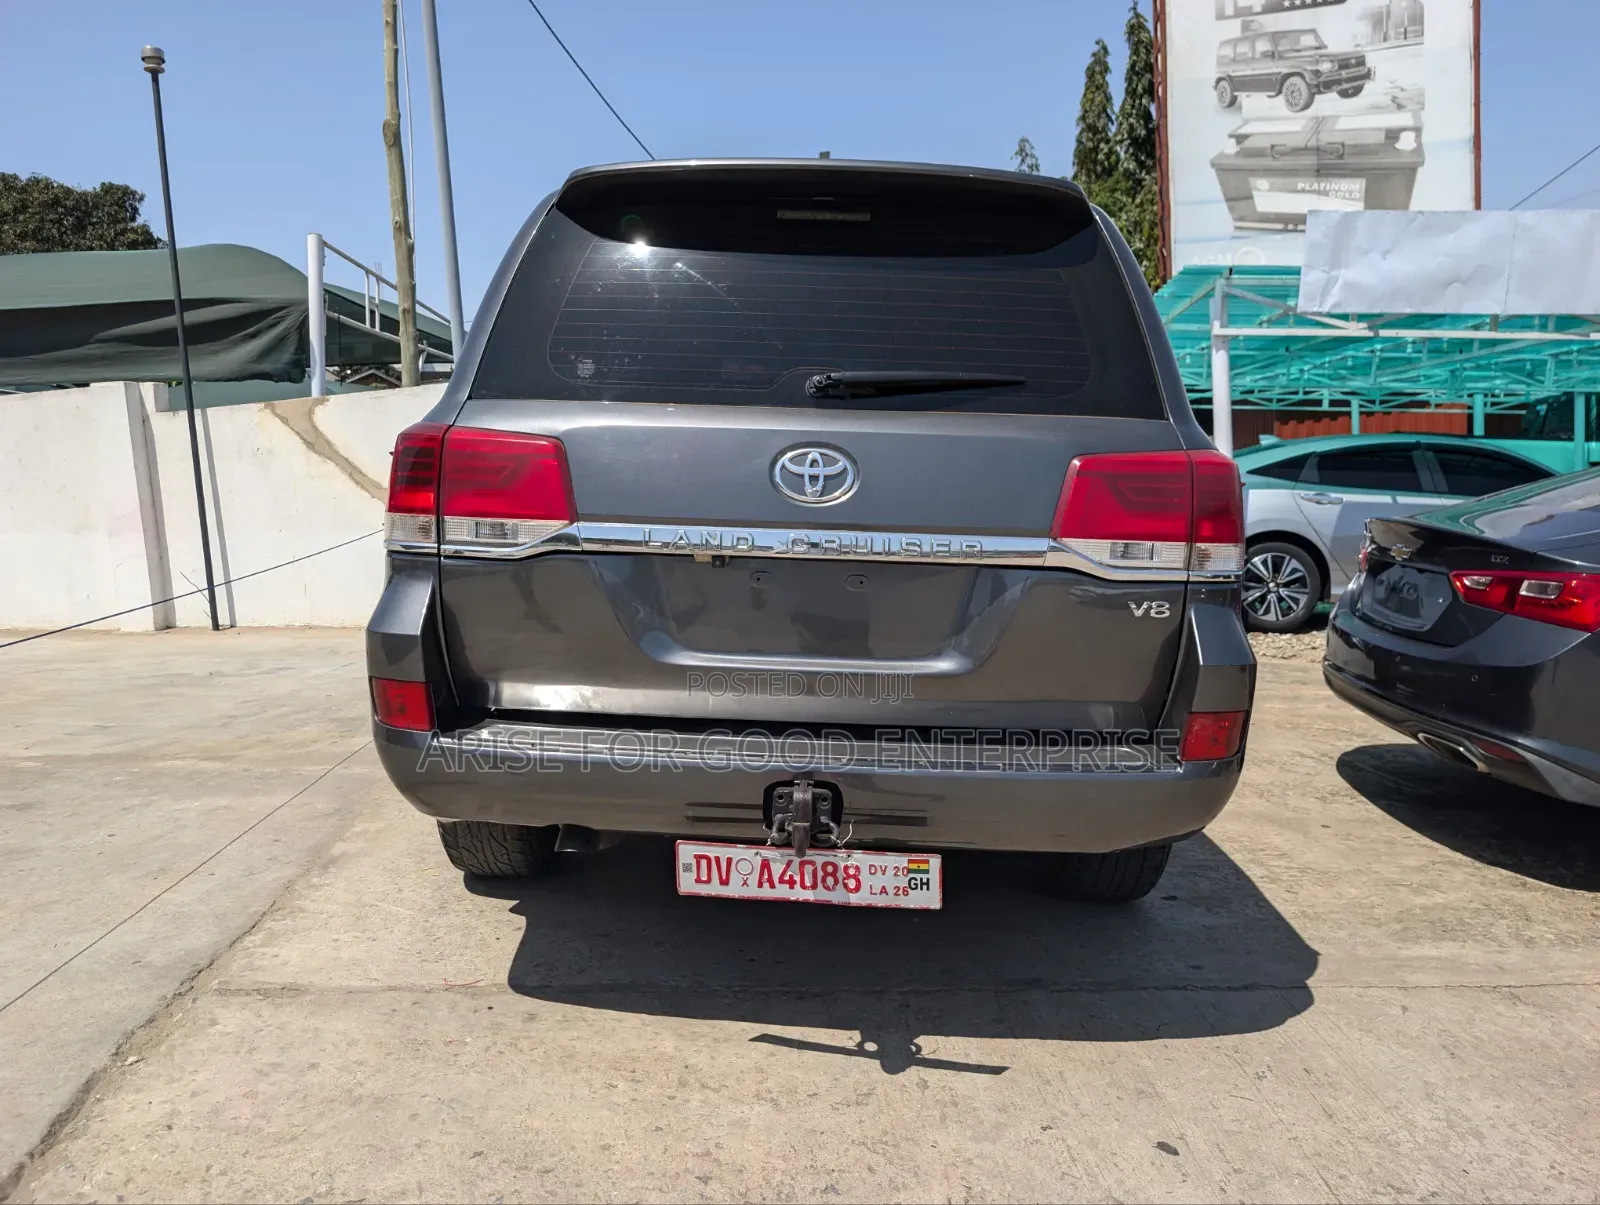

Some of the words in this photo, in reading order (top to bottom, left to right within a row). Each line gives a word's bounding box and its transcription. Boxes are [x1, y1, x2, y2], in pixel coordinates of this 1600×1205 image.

[1297, 182, 1360, 191] PLATINUM
[1328, 191, 1360, 199] GOLD
[643, 529, 754, 551] LAND
[787, 533, 983, 559] CRUISER
[1127, 601, 1170, 618] V8
[694, 853, 733, 886] DV
[757, 858, 862, 894] A4088
[869, 864, 888, 876] DV
[870, 883, 888, 896] LA
[893, 885, 909, 897] 26
[908, 876, 930, 891] GH
